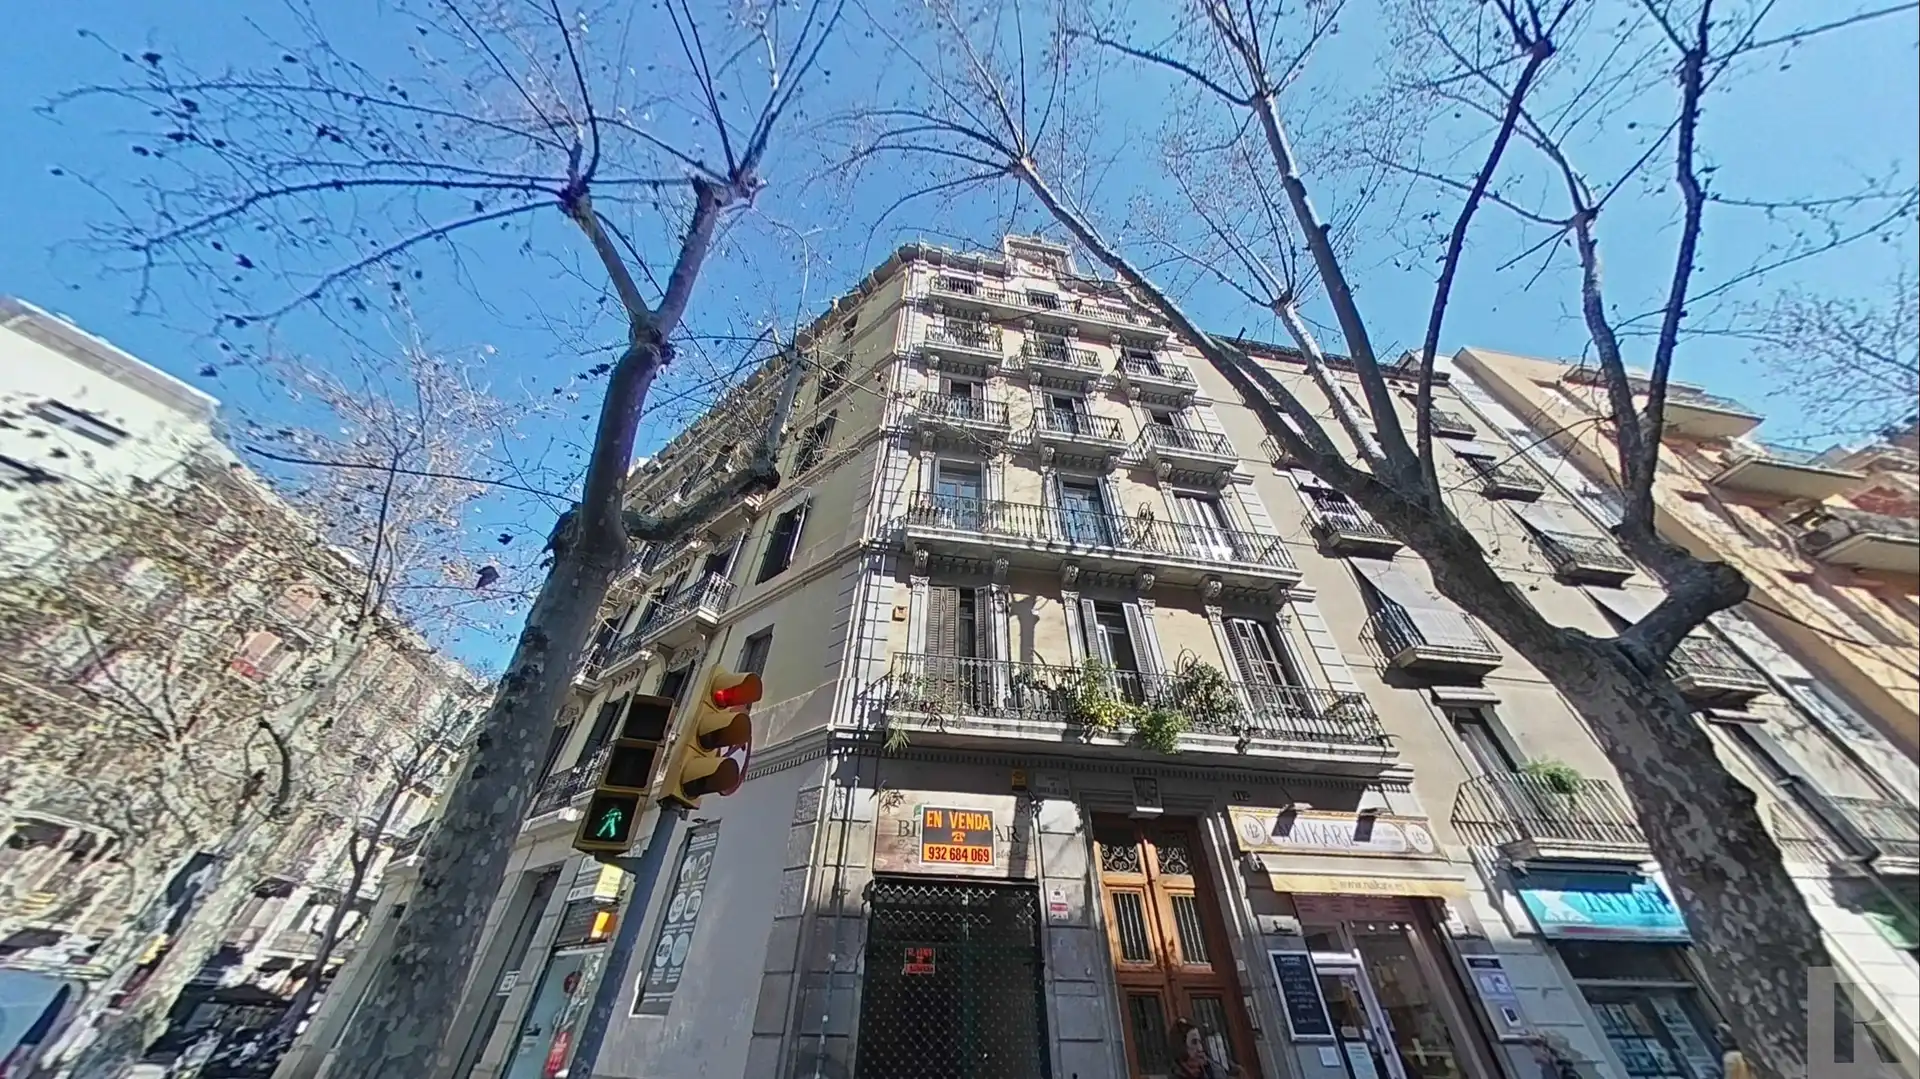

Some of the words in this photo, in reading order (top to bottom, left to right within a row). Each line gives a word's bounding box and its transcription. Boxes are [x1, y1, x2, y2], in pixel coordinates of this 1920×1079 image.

[926, 810, 942, 828] EN
[948, 811, 991, 831] VENDA
[928, 845, 947, 860] 932
[949, 847, 968, 862] 684
[971, 848, 990, 862] 069
